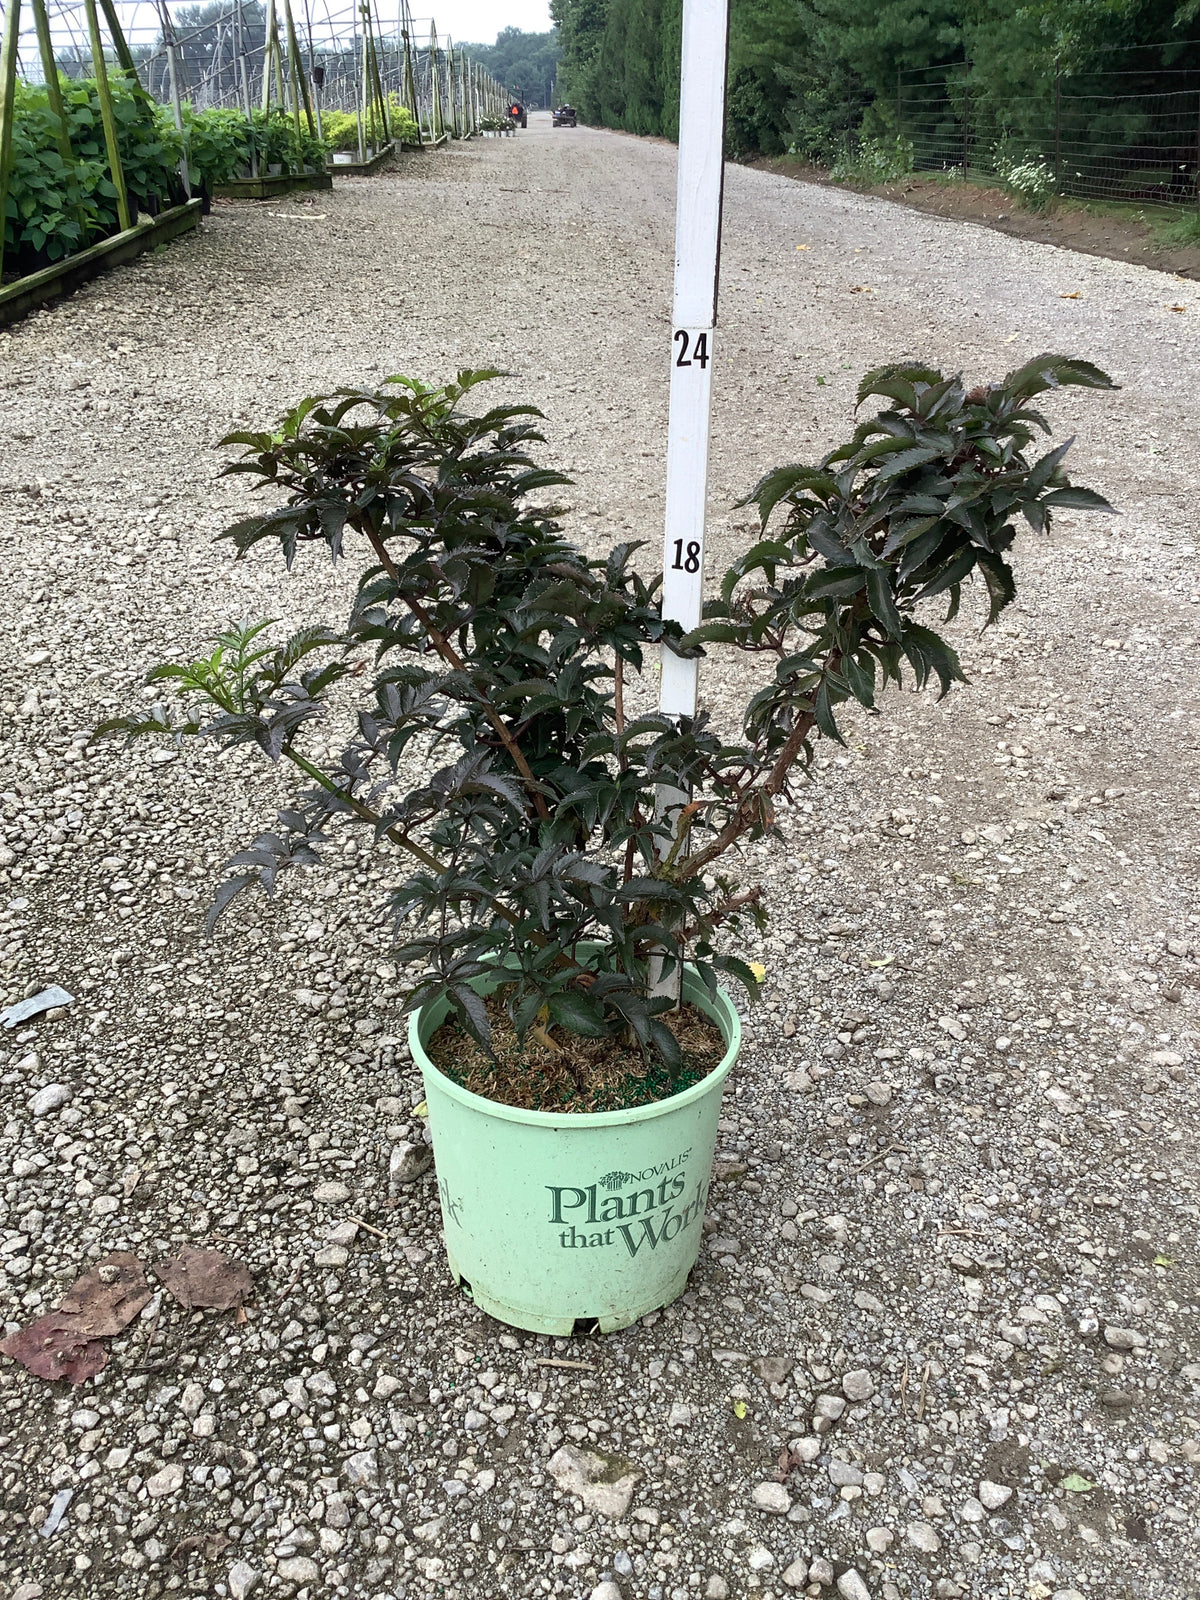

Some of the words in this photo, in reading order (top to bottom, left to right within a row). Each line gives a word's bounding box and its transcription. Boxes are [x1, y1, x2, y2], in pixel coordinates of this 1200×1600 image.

[674, 329, 710, 369] 24
[671, 538, 701, 574] 18
[630, 1149, 691, 1184] NOVALIS
[545, 1171, 686, 1225] Plants
[558, 1225, 615, 1249] that
[616, 1178, 707, 1258] Work
